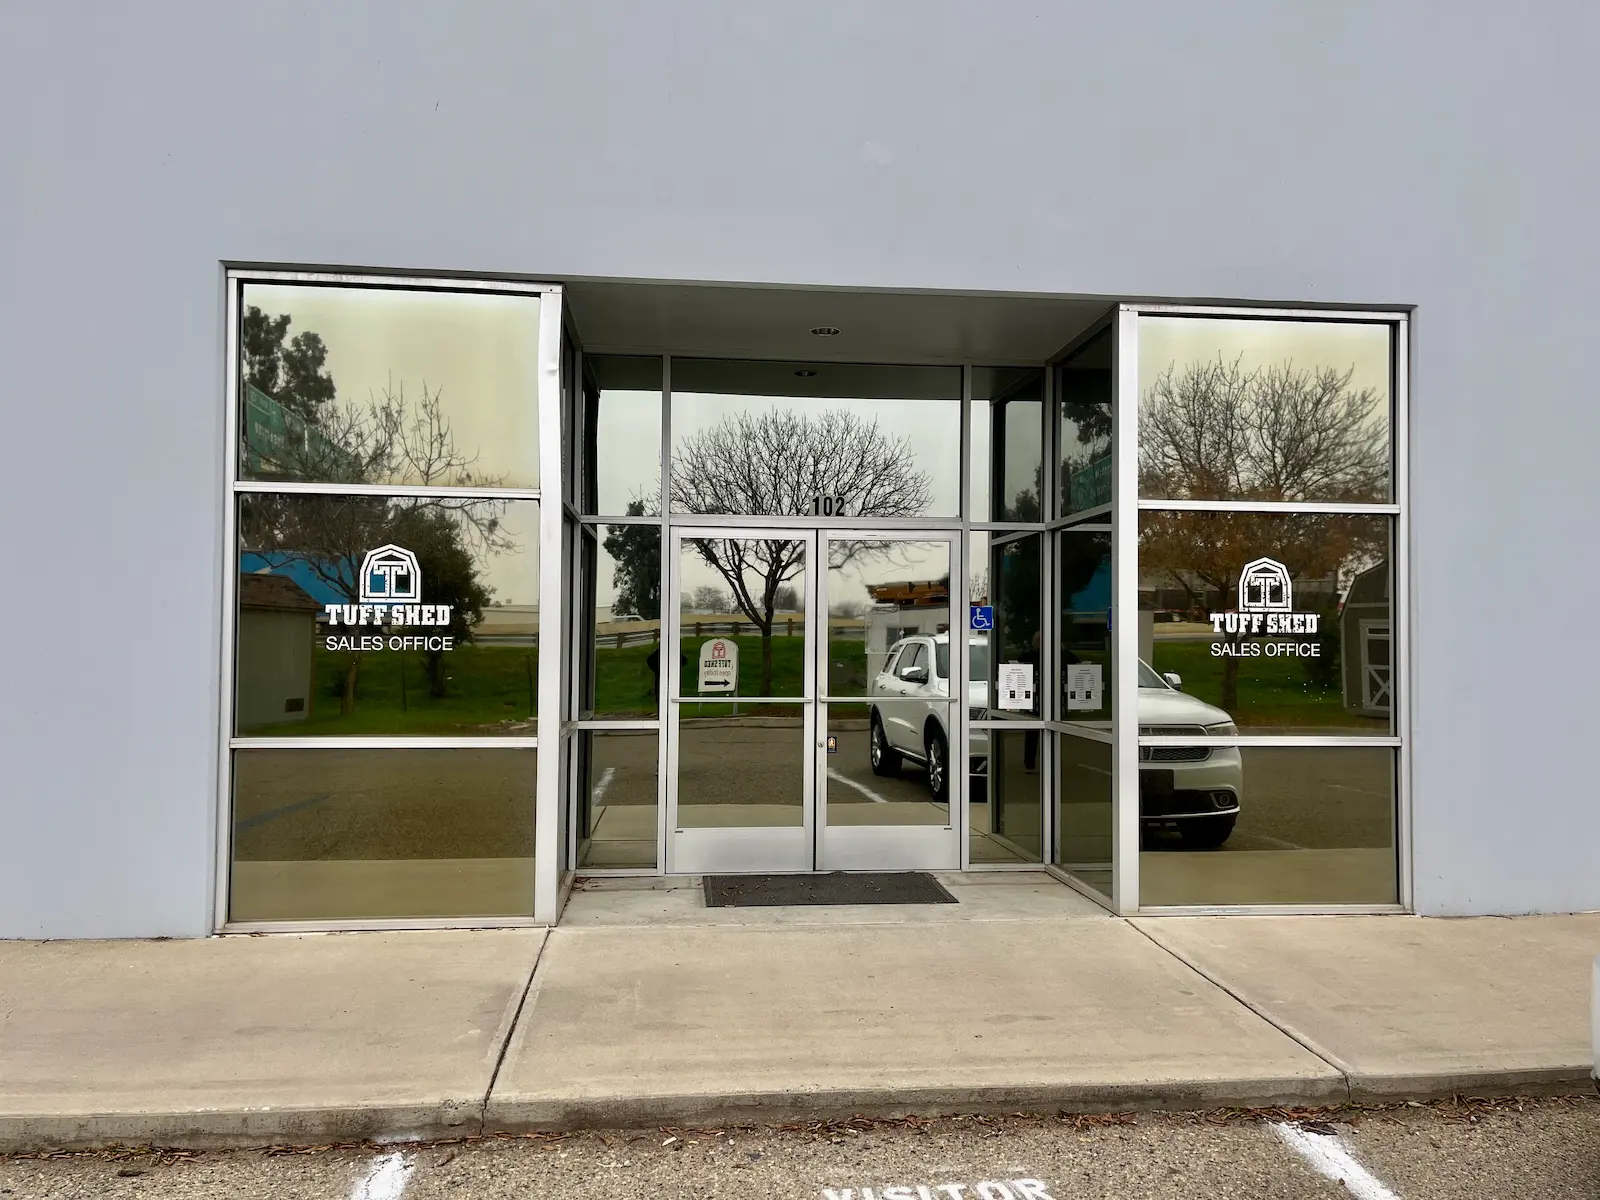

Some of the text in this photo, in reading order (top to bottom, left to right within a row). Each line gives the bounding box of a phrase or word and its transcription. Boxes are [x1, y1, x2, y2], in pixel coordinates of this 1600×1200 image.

[812, 496, 845, 517] 102
[325, 604, 451, 626] TUFF SHED
[1209, 613, 1263, 634] TUFF
[325, 635, 453, 651] SALES OFFICE
[1210, 642, 1321, 657] SALES OFFICE
